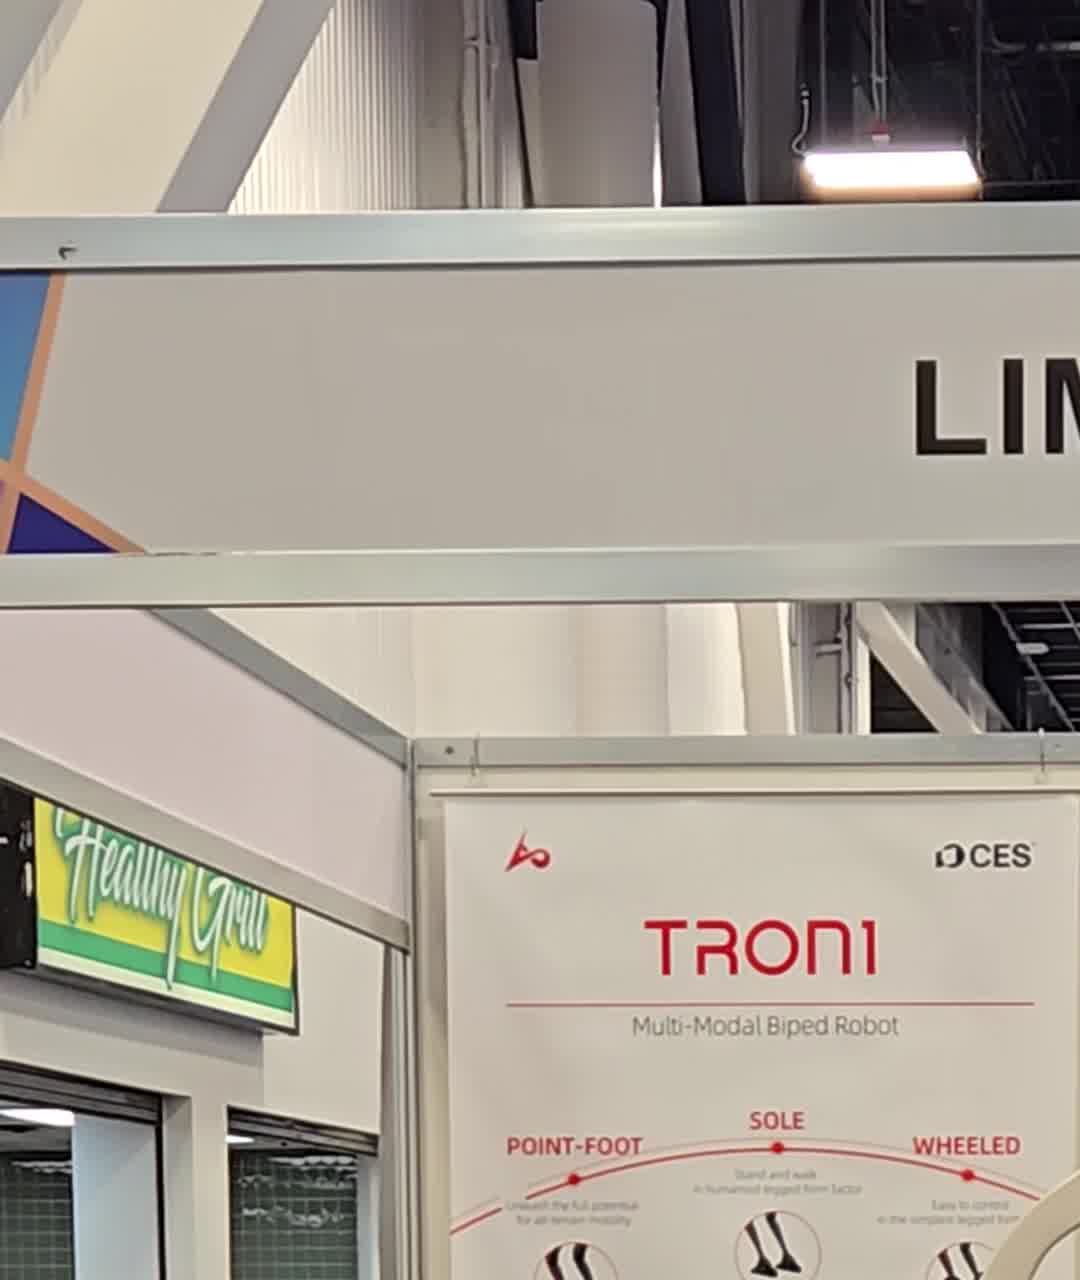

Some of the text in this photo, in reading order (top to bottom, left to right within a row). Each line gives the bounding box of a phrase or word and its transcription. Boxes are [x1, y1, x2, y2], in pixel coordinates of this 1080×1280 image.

[969, 843, 1032, 868] CES
[632, 1015, 899, 1040] Multi-Modal Biped Robot
[749, 1111, 805, 1131] SOLE
[507, 1136, 643, 1156] POINT-FOOT
[912, 1136, 1021, 1156] WHEELED
